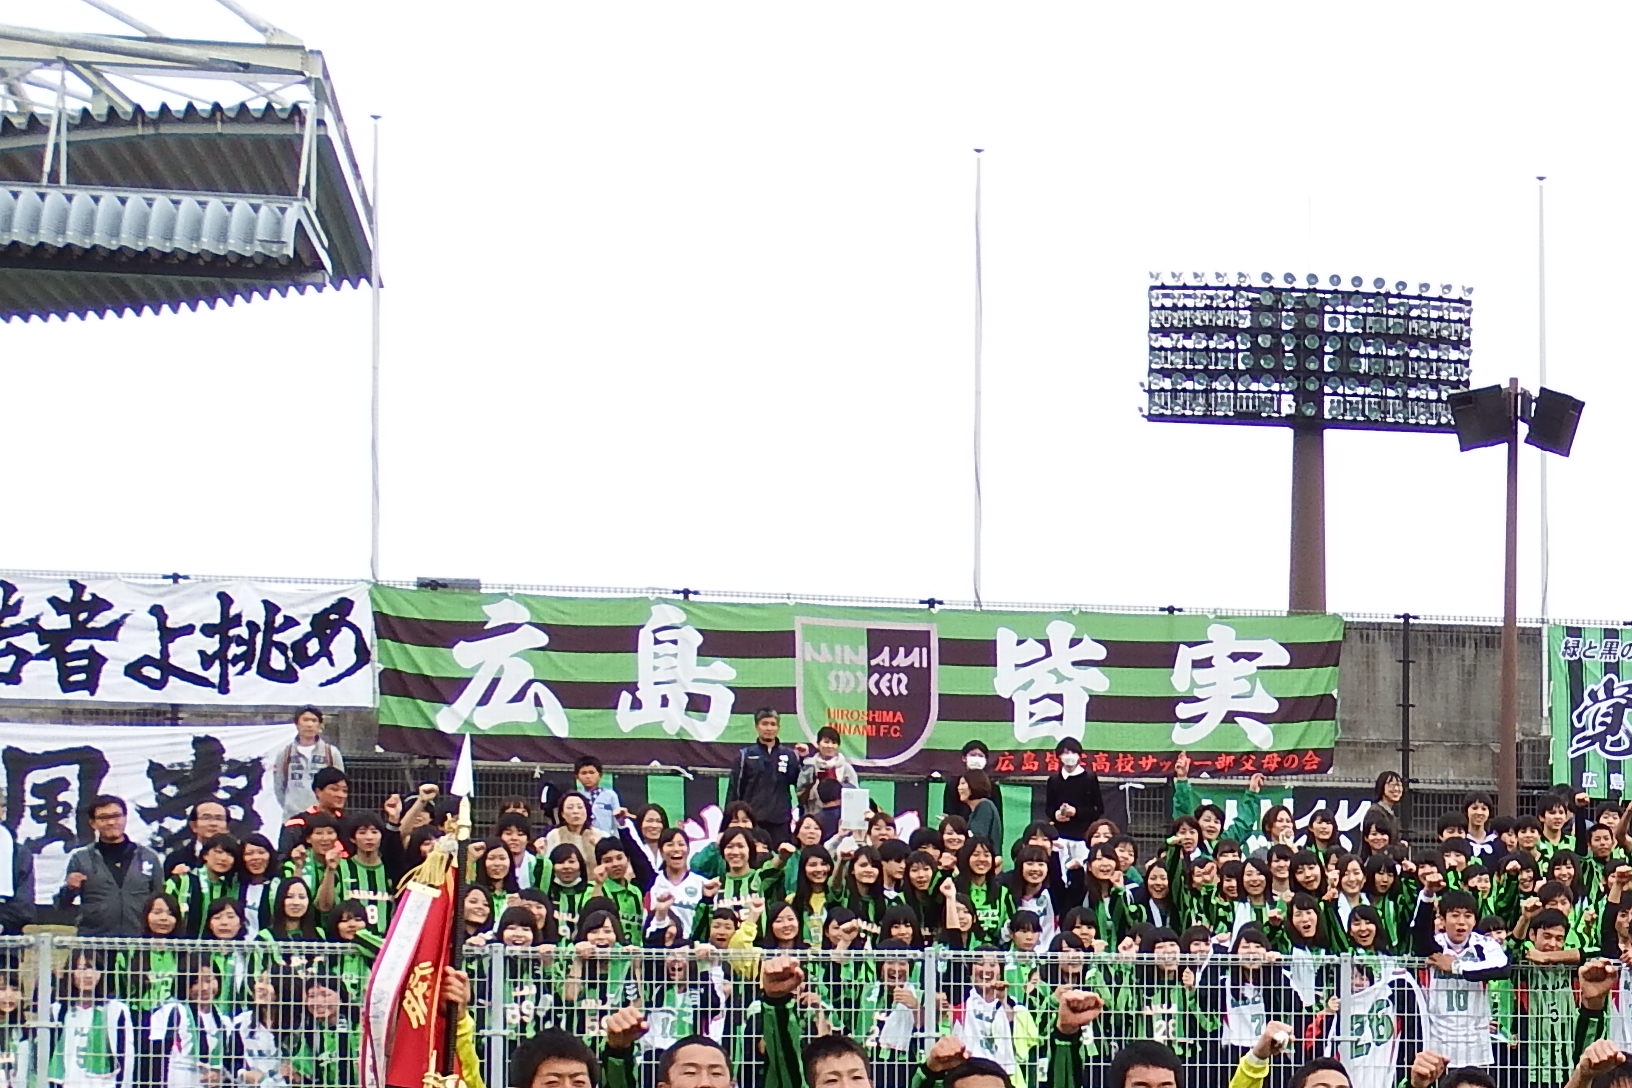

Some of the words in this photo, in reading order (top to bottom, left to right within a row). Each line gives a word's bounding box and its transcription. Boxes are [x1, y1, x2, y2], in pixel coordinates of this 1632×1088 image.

[435, 599, 738, 741] 広島
[993, 620, 1292, 749] 皆実
[994, 750, 1322, 773] 広島皆高校サッー部父母の会
